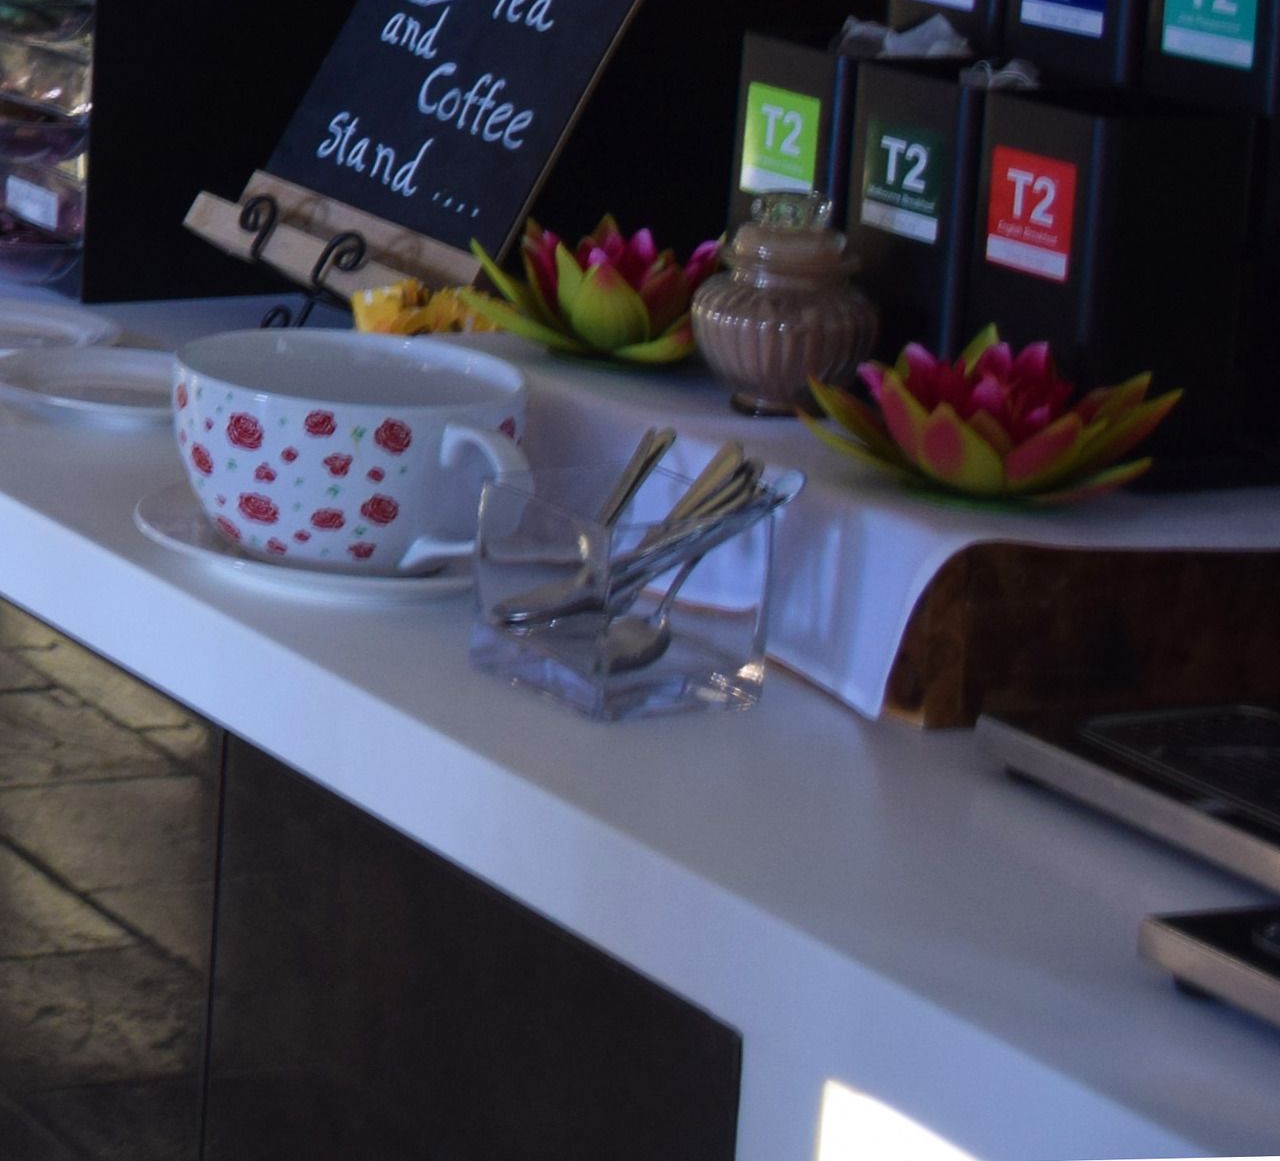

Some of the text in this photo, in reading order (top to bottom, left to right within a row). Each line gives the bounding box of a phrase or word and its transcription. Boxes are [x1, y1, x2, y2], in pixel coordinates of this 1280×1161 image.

[380, 6, 451, 60] and
[417, 61, 534, 151] Coffee
[761, 103, 803, 157] T2
[880, 135, 929, 194] T2
[1006, 167, 1057, 229] T2
